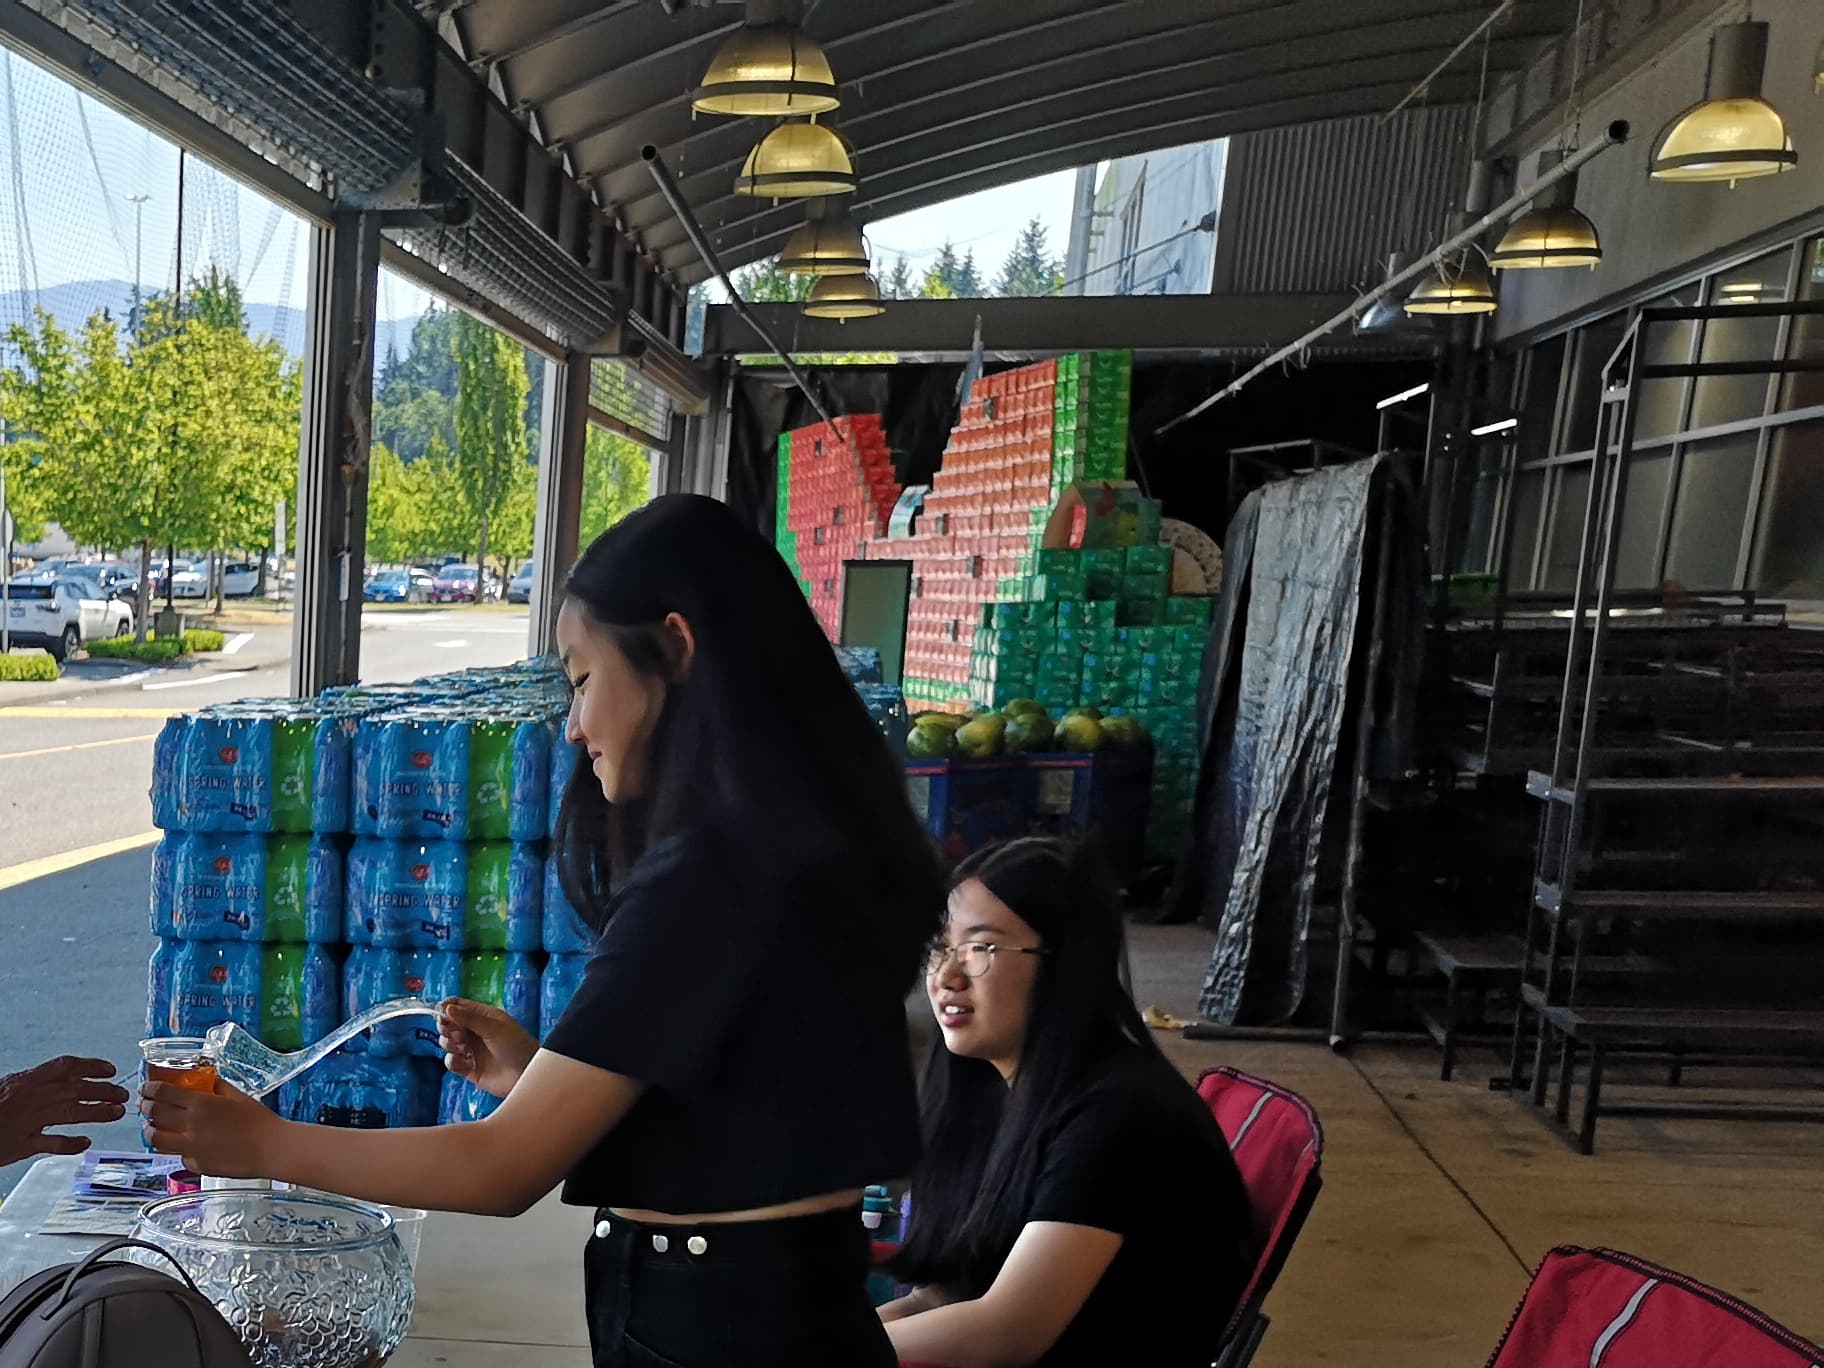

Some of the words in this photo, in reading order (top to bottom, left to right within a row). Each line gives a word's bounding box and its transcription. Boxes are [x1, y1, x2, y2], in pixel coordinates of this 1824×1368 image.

[188, 776, 226, 789] SPRING
[233, 776, 266, 789] WATER
[380, 783, 419, 796] SPRING
[182, 885, 221, 898] SPRING
[226, 885, 260, 899] WATER
[424, 893, 461, 908] WATER
[177, 993, 216, 1008] SPRING
[221, 994, 257, 1008] WATER
